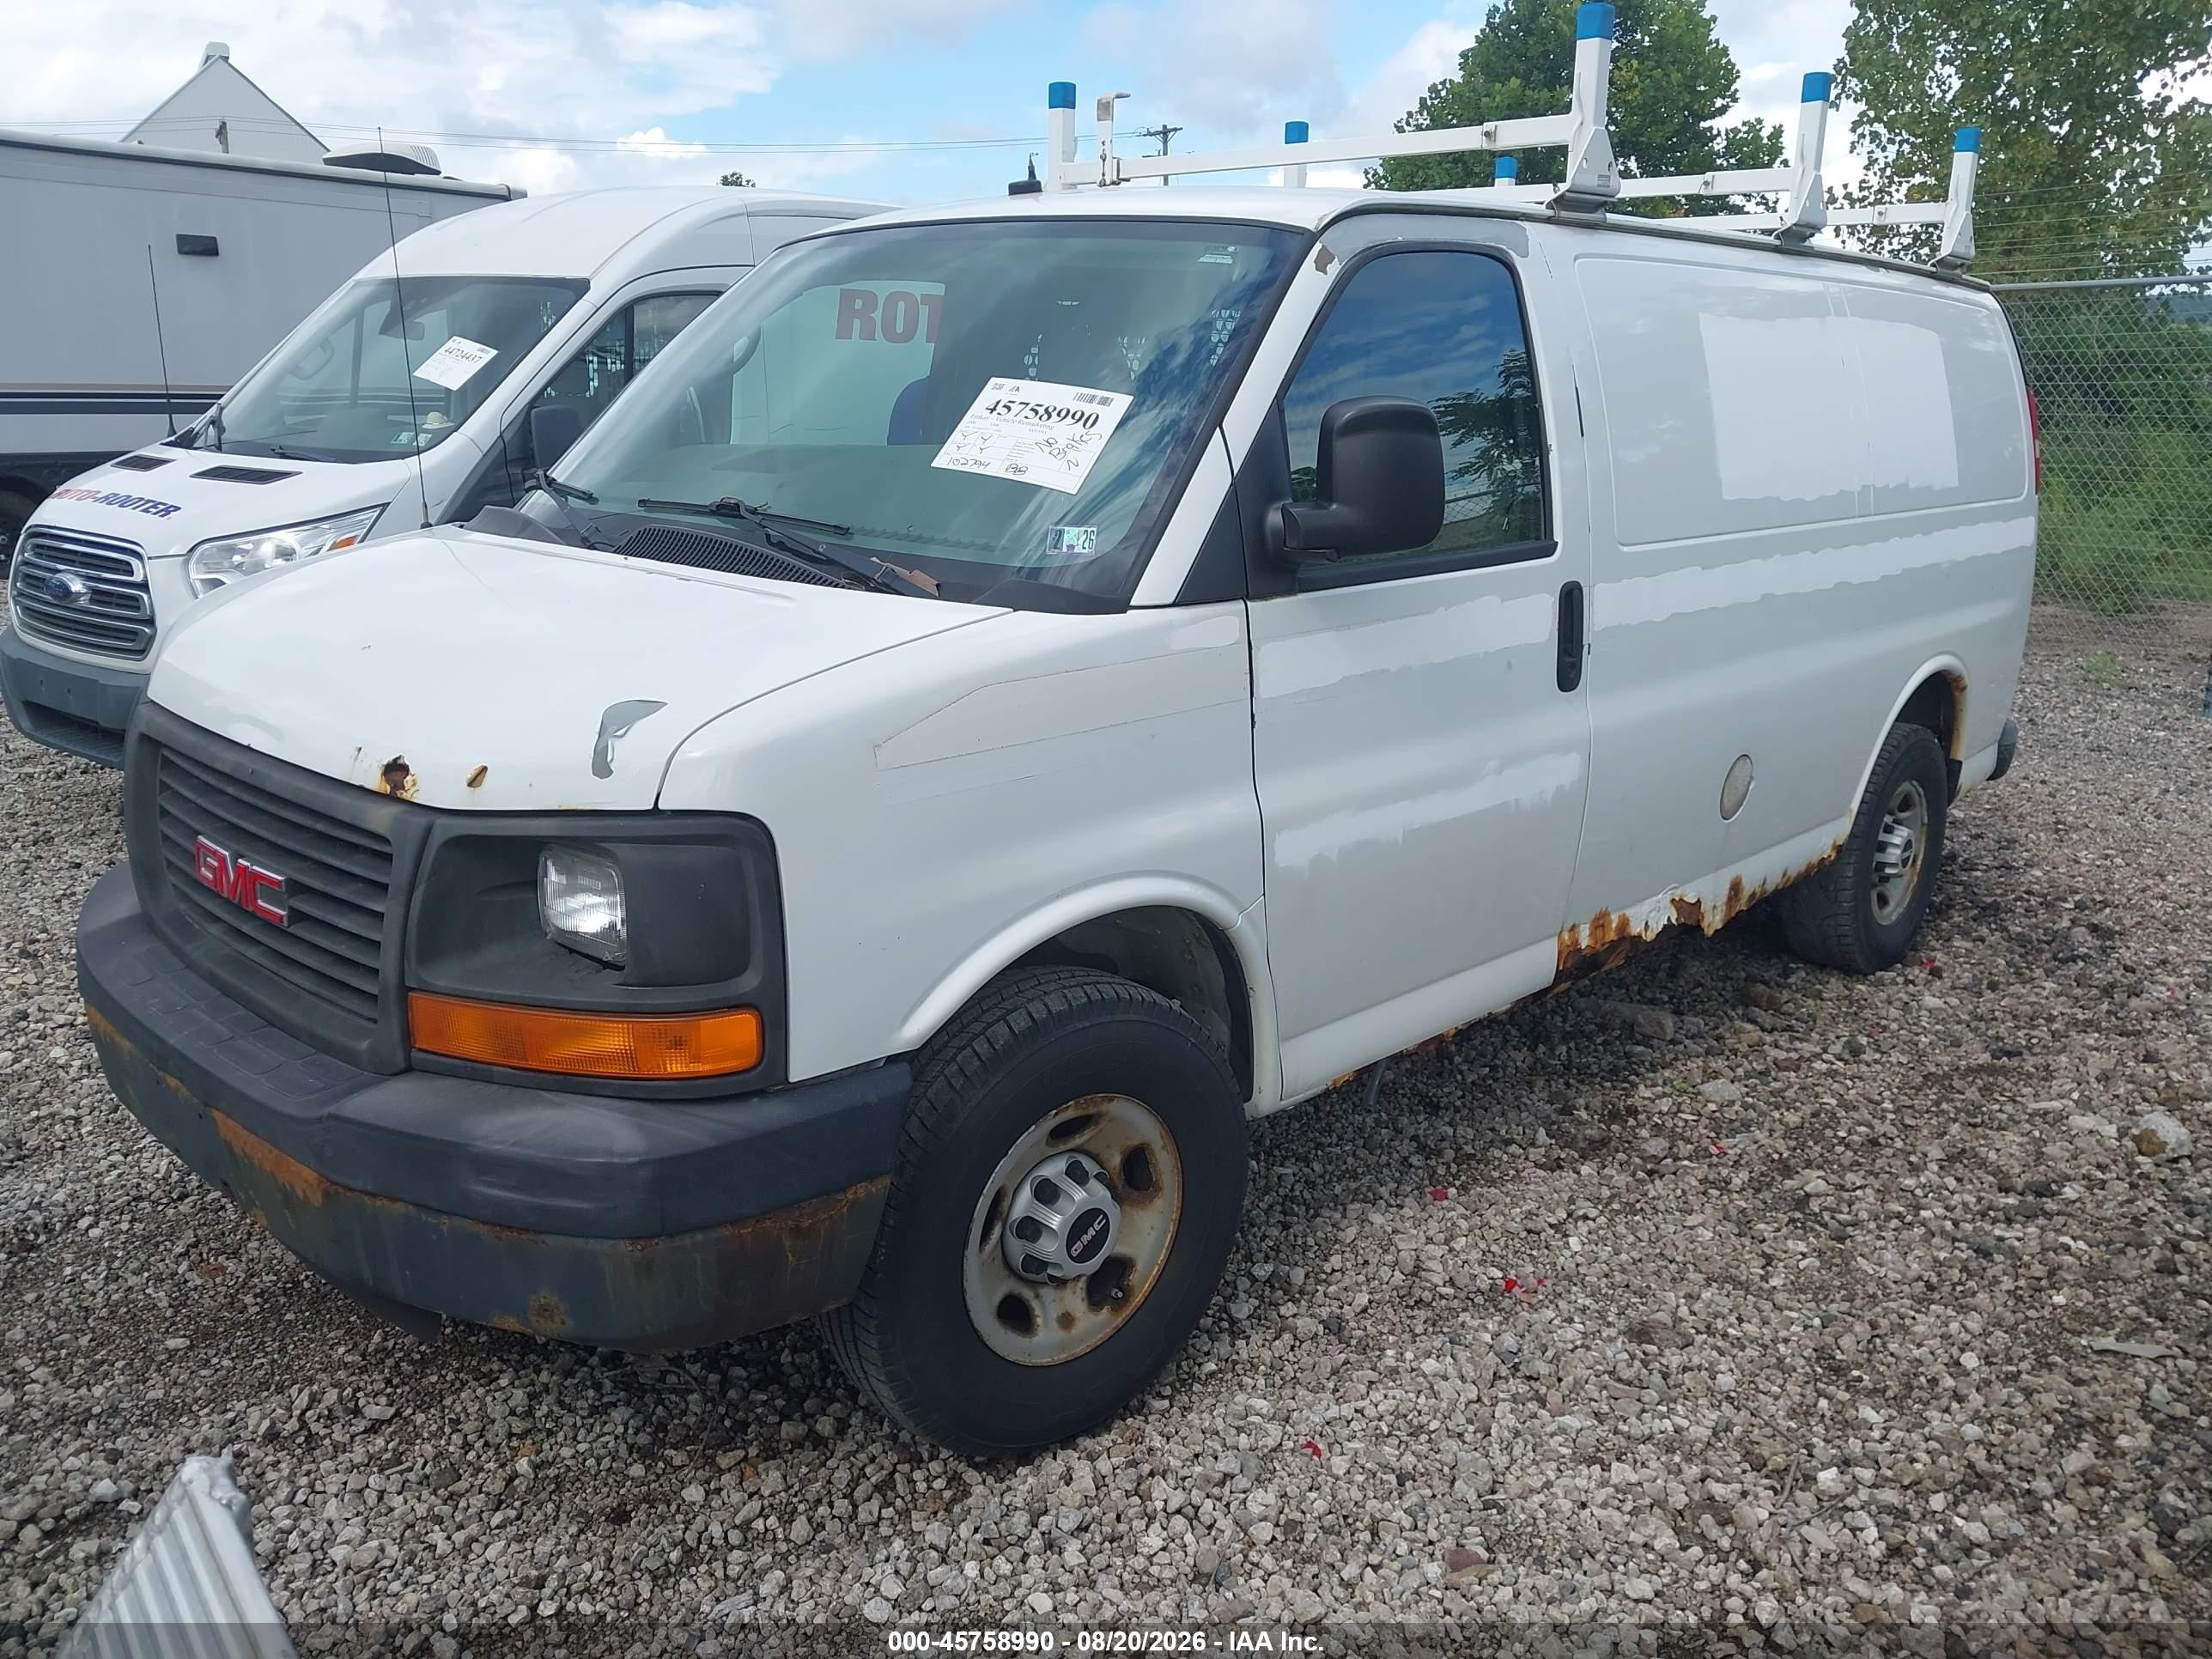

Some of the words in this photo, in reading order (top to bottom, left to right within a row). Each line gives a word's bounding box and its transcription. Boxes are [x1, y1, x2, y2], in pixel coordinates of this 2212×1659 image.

[985, 398, 1099, 429] 45758990
[996, 416, 1017, 424] Vehicle
[1018, 419, 1054, 431] Remarketing
[1035, 437, 1058, 453] No
[1082, 529, 1095, 550] 26
[194, 835, 289, 927] GMC
[1070, 1214, 1107, 1257] GMC
